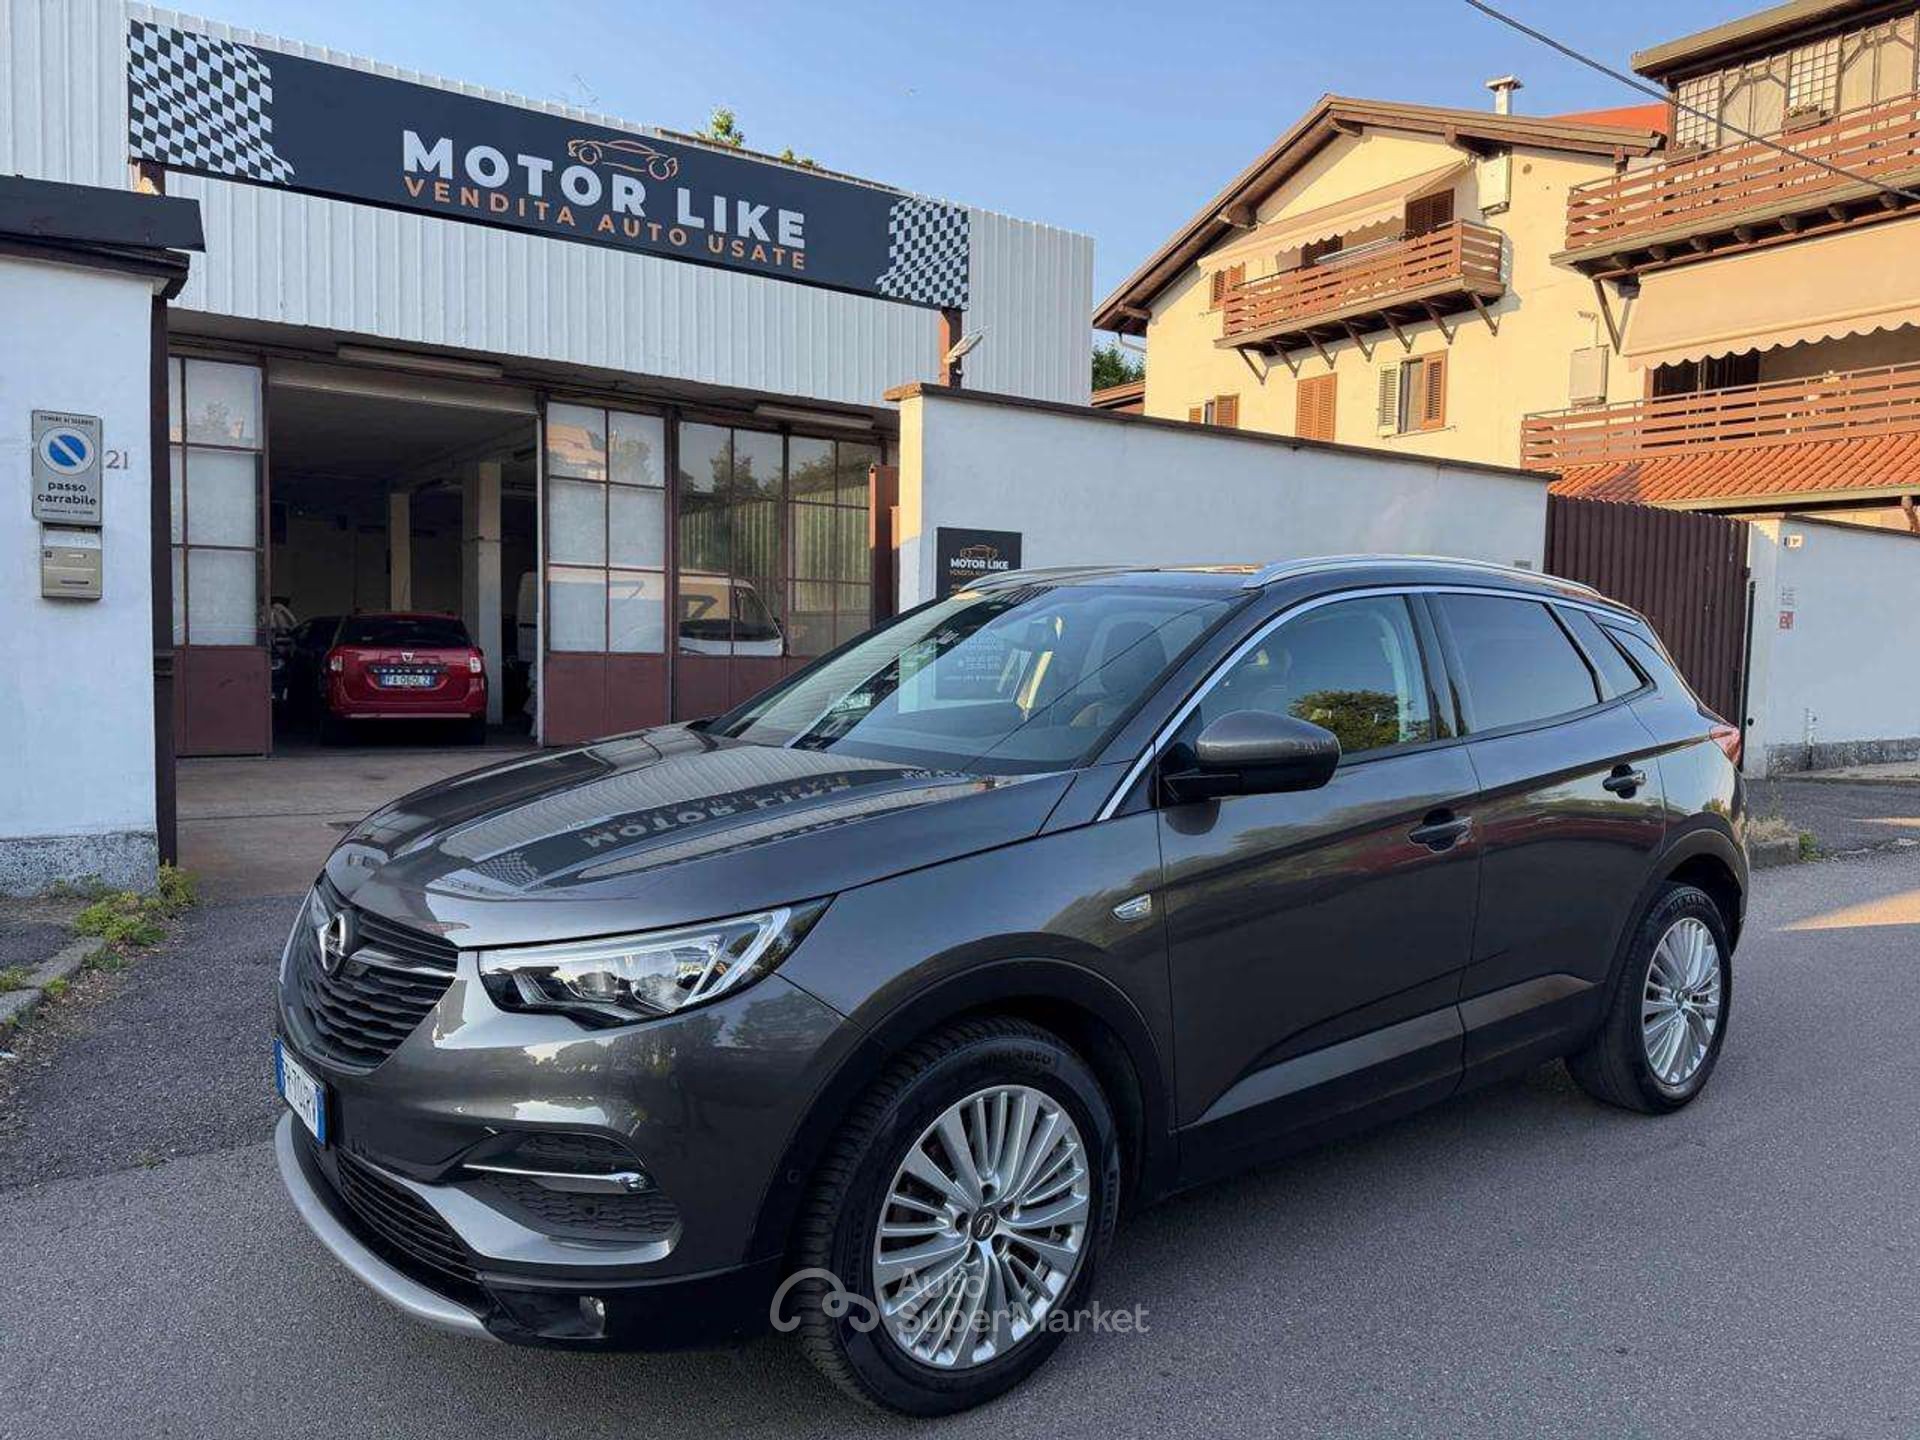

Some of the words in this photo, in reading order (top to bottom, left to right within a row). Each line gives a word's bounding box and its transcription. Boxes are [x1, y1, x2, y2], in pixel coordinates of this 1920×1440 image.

[403, 130, 646, 218] MOTOR
[677, 187, 806, 249] LIKE
[404, 176, 576, 227] VENDITA
[598, 214, 688, 247] AUTO
[709, 235, 806, 270] USATE
[106, 450, 129, 469] 21
[48, 482, 87, 493] passo
[38, 494, 97, 505] carrabile
[950, 558, 986, 569] MOTOR
[987, 560, 1009, 570] LIKE
